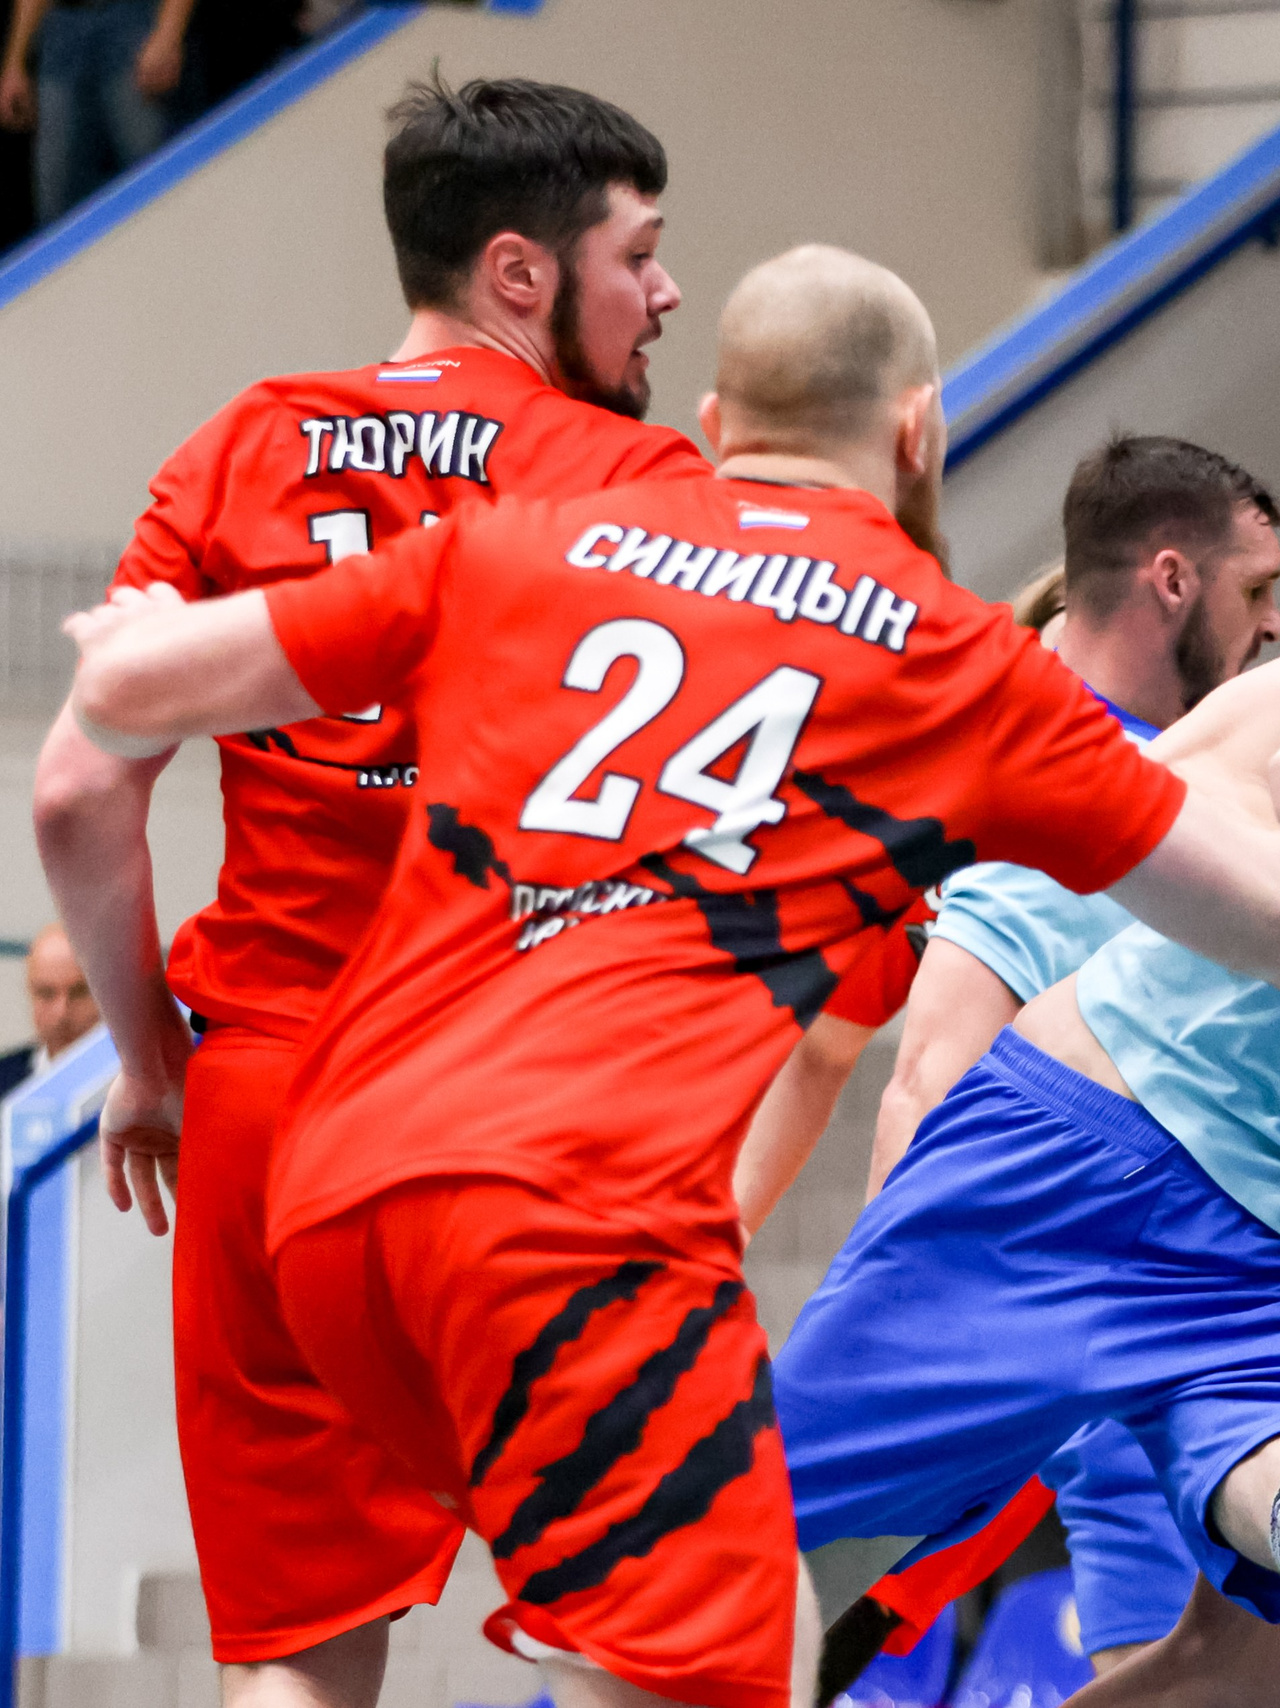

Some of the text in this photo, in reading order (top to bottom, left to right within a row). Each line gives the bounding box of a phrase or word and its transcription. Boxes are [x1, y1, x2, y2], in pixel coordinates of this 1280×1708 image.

[301, 411, 503, 484] ТЮРИН
[565, 523, 919, 653] СИНИЦЫН
[518, 616, 825, 876] 24
